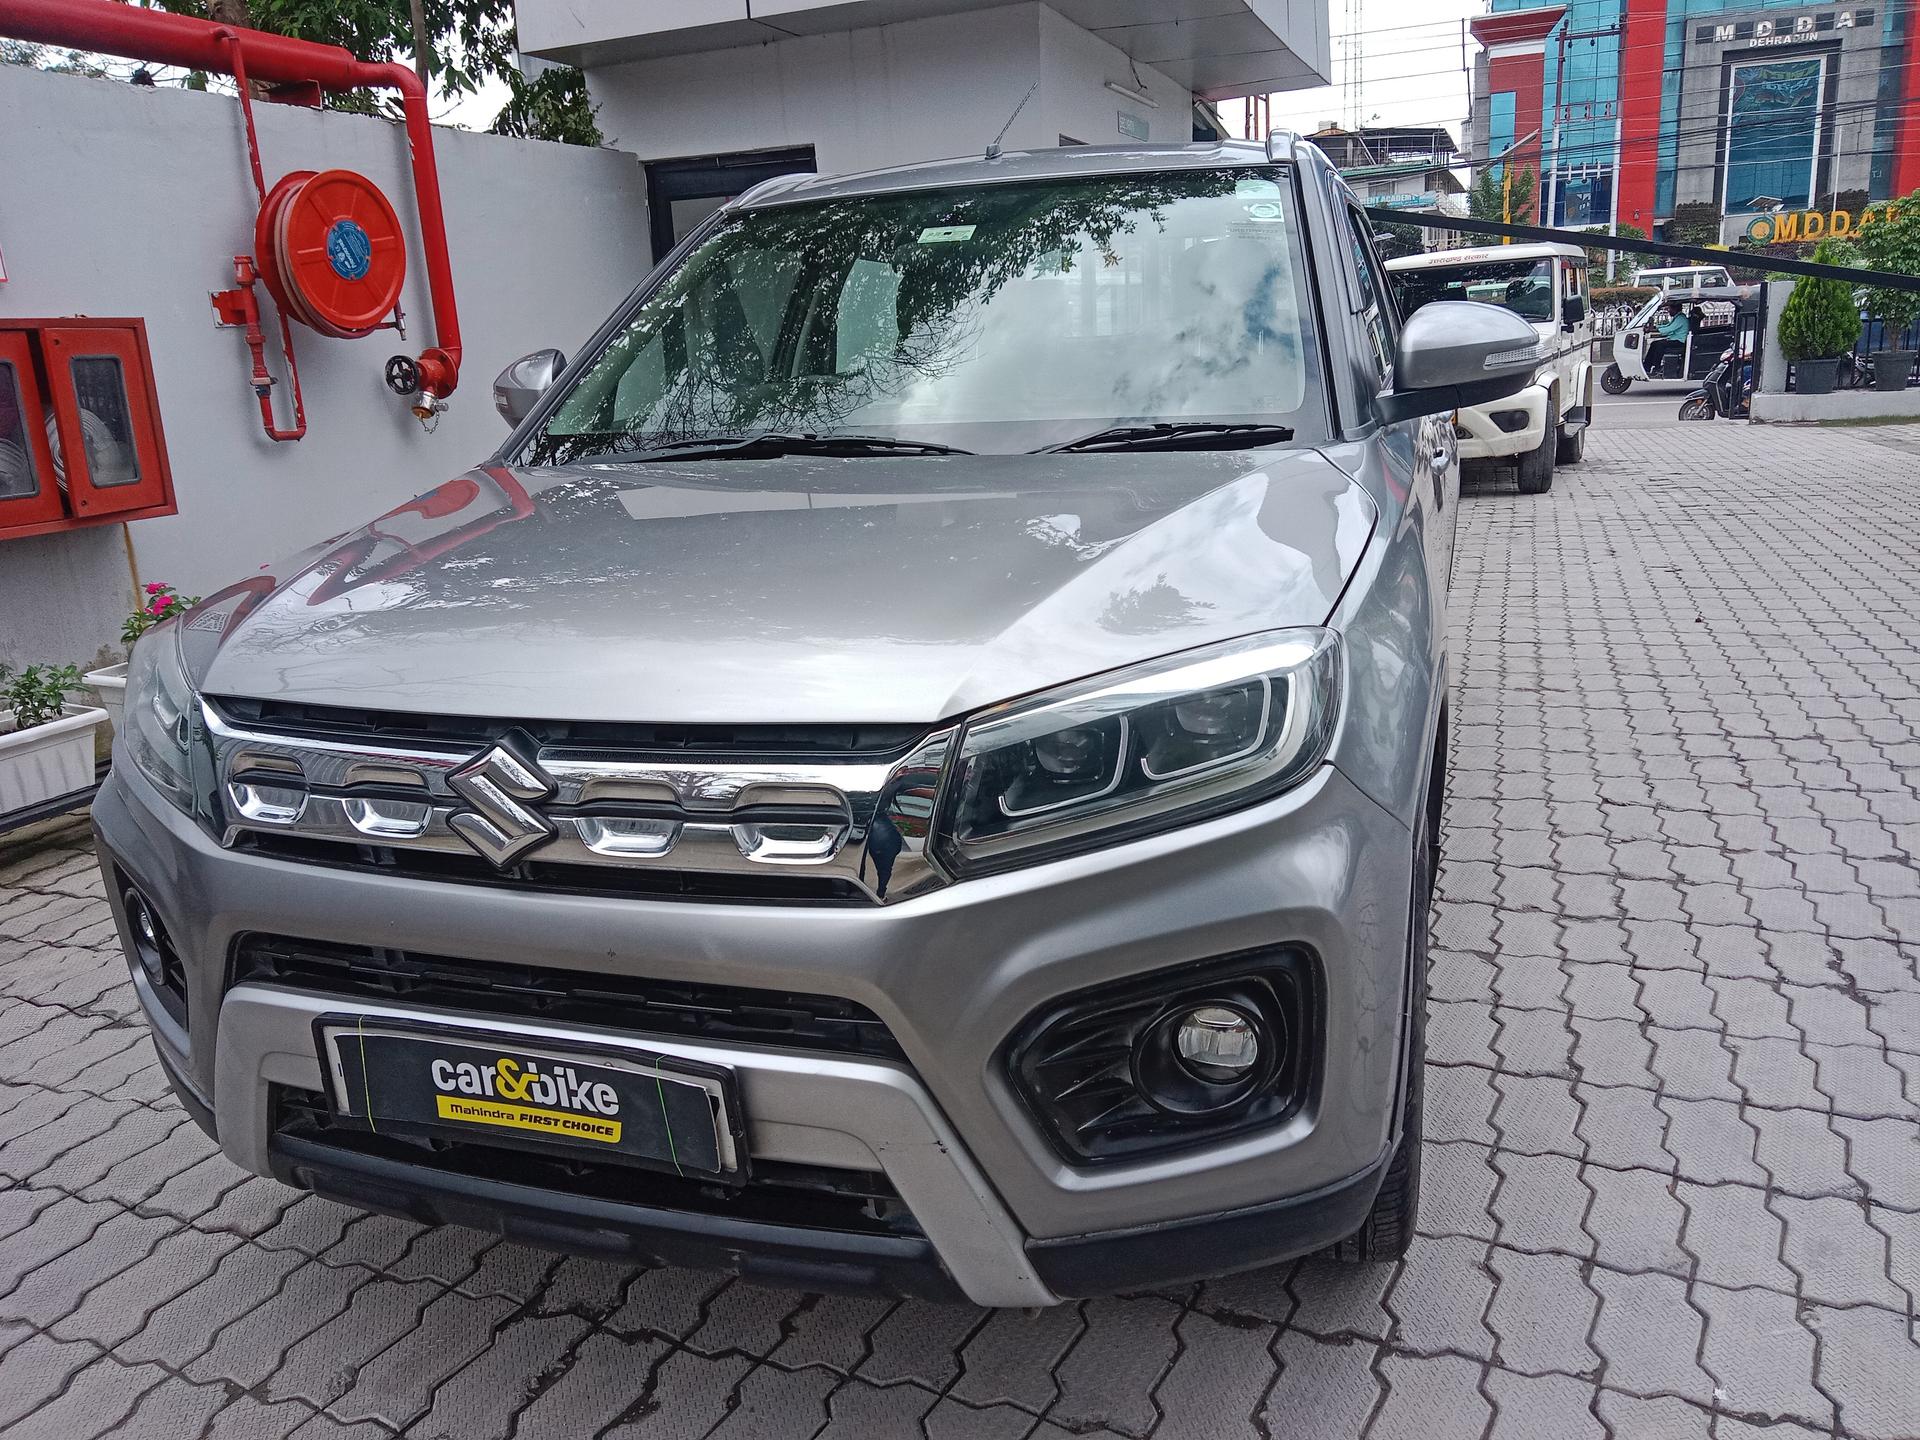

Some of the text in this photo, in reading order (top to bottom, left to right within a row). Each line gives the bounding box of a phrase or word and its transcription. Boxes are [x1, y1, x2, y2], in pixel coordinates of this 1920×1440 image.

[1749, 32, 1819, 47] DEHRADUN
[431, 1057, 620, 1116] car&bike
[450, 1104, 615, 1137] Mahindra FIRST CHOICE
